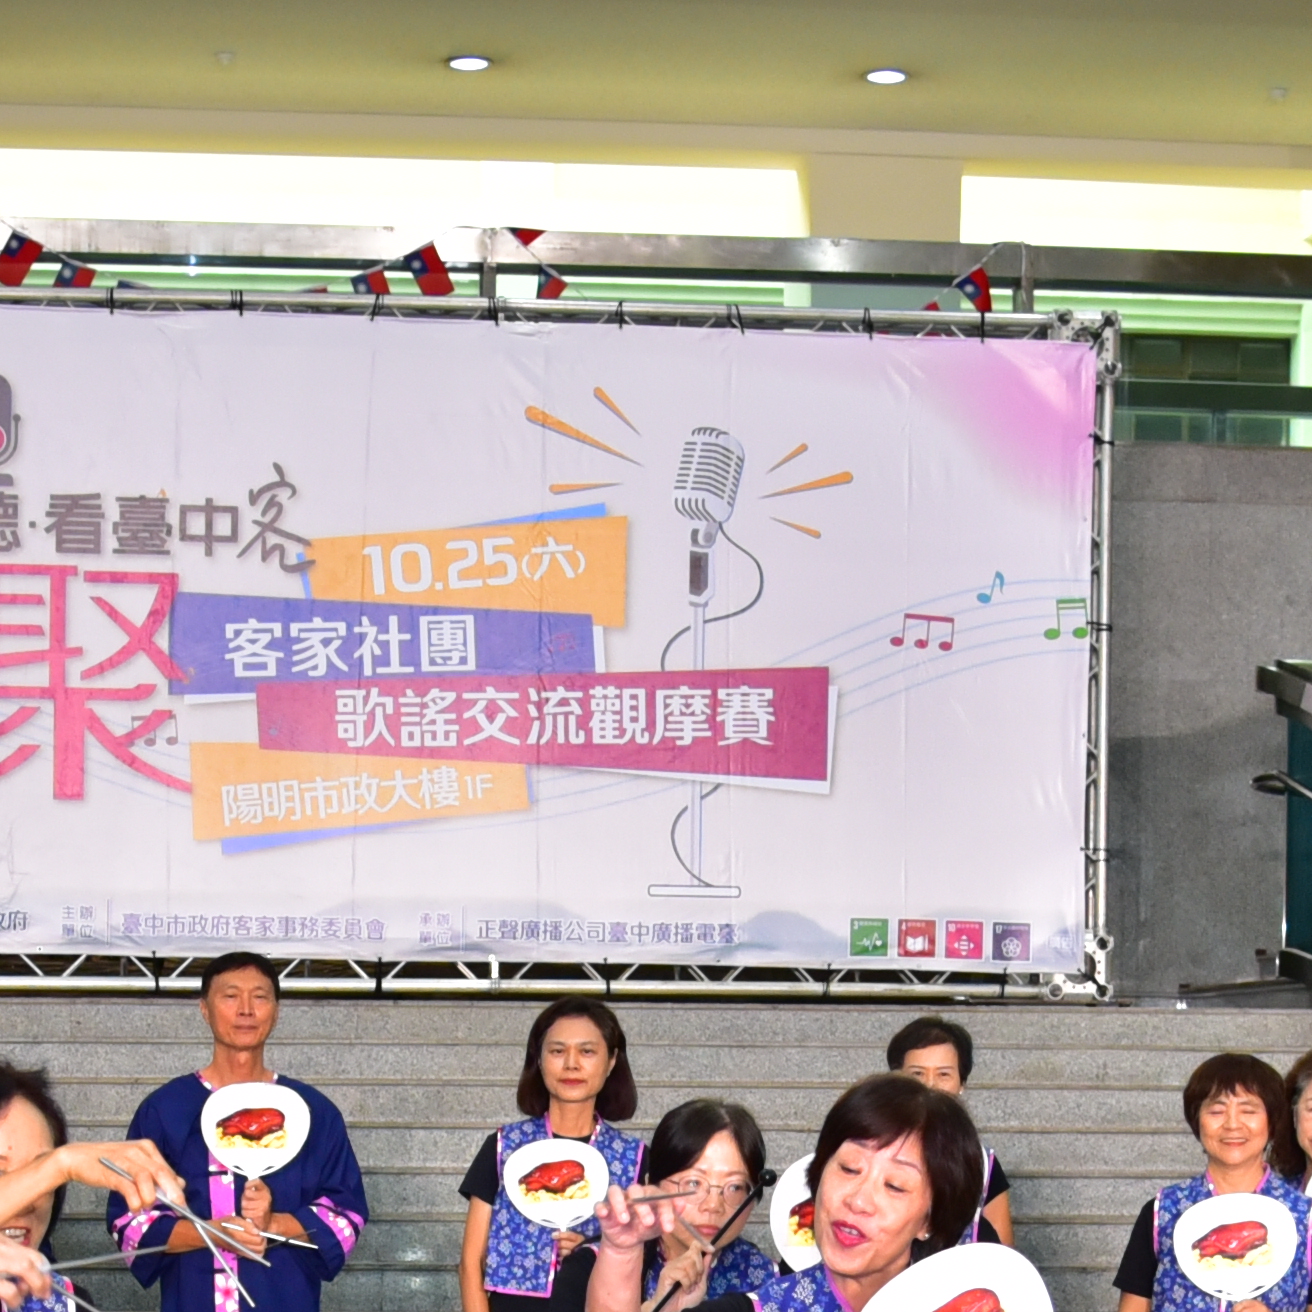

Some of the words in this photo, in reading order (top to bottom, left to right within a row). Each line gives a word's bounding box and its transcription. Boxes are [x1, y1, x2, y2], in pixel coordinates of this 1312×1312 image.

[225, 615, 476, 678] 客家社團
[335, 685, 776, 748] 歌謠交流觀摩賽
[121, 912, 386, 941] 臺中市政府客家事務委員會
[477, 918, 737, 945] 正聲廣播公司臺中廣播電臺
